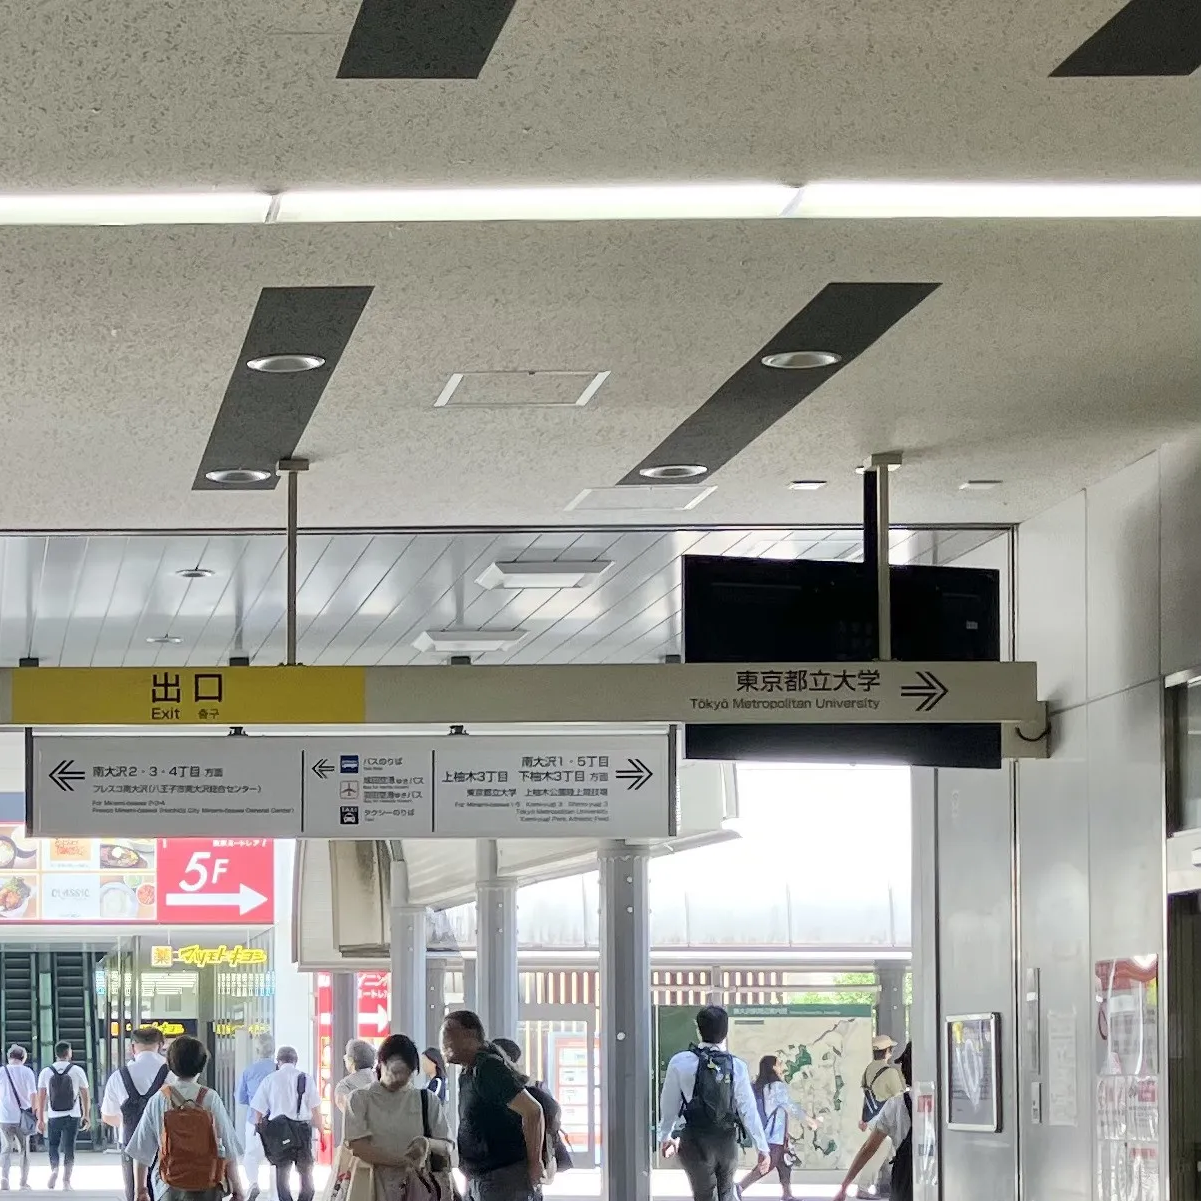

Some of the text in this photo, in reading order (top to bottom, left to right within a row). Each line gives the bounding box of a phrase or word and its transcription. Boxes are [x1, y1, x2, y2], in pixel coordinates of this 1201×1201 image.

[151, 672, 223, 703] 出口
[736, 669, 881, 692] 東京都立大学
[732, 698, 812, 710] Metropolitan
[815, 698, 881, 710] University
[151, 707, 180, 720] Exit
[363, 757, 403, 766] バスのりば
[179, 851, 230, 892] 5F
